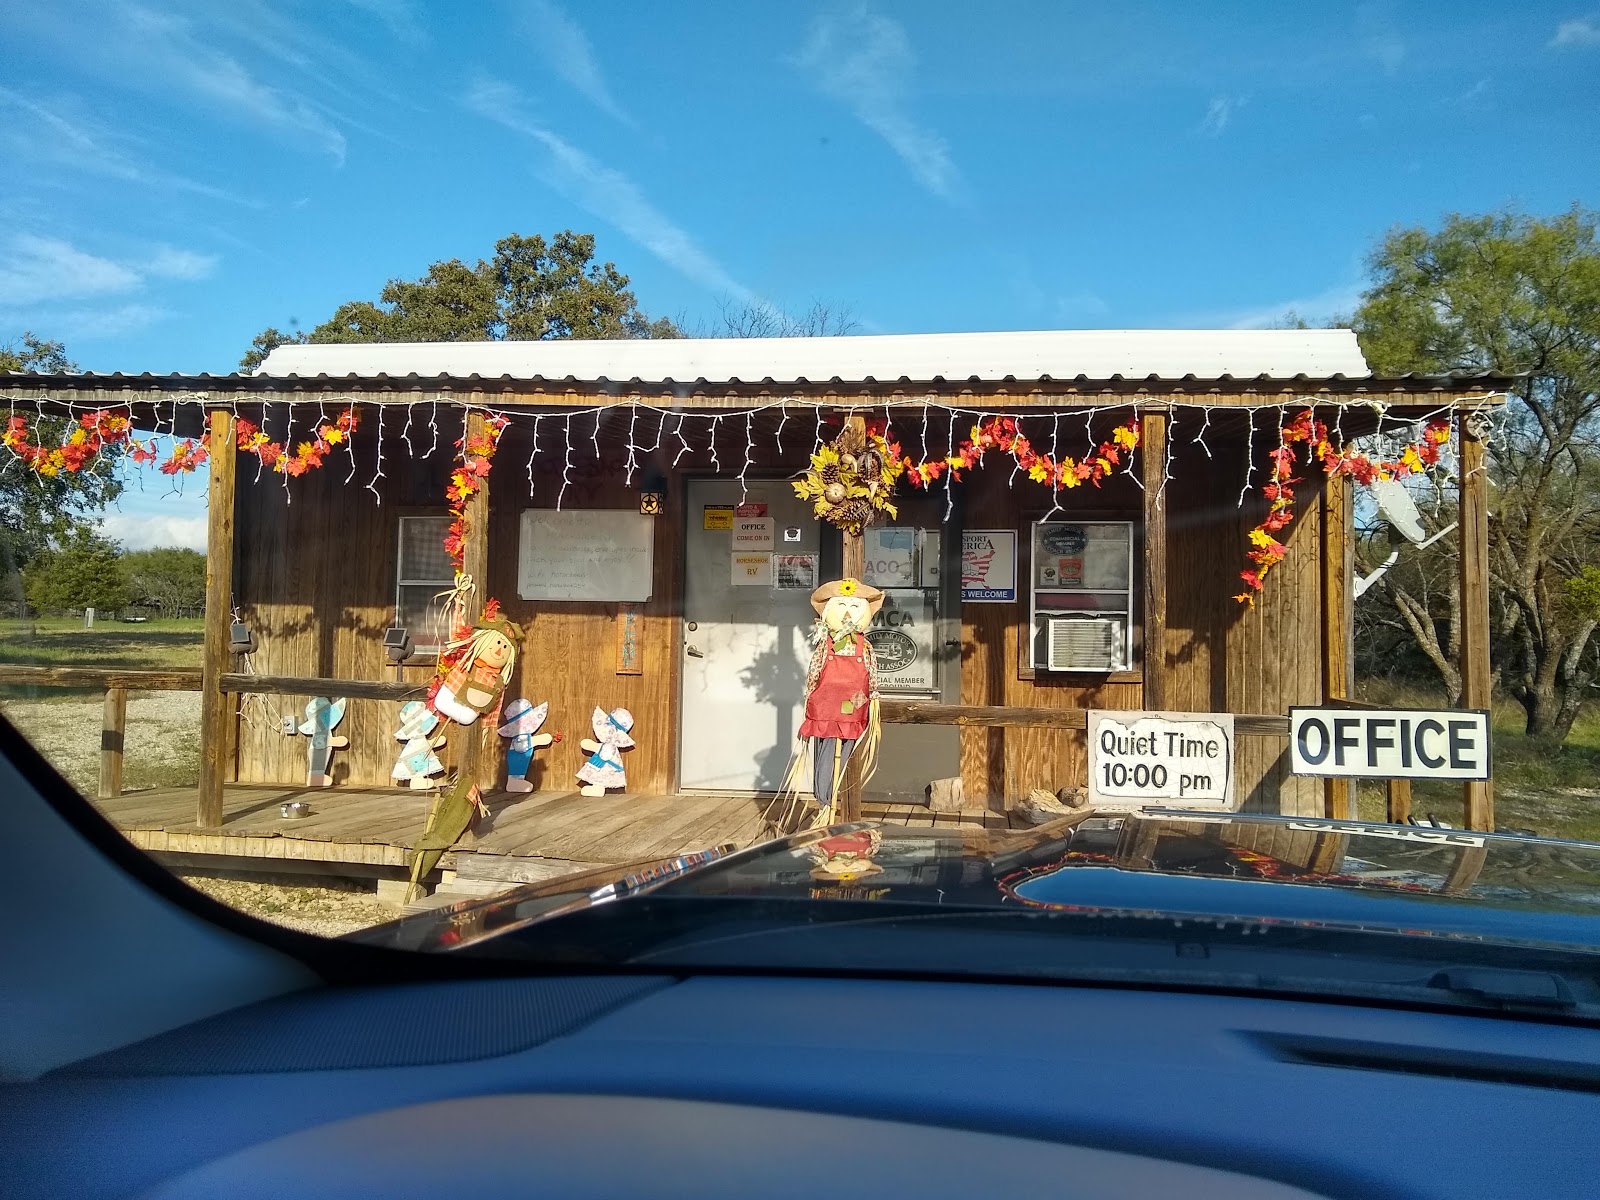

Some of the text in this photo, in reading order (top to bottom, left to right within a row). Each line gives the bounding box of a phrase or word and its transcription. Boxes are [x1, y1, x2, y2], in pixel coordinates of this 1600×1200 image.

[747, 567, 758, 575] RV
[967, 590, 1008, 598] WELCOME
[884, 632, 911, 646] MOTOR
[1101, 729, 1219, 759] Quiet Time
[1297, 717, 1478, 769] OFFICE
[1103, 762, 1212, 797] 10:00 pm
